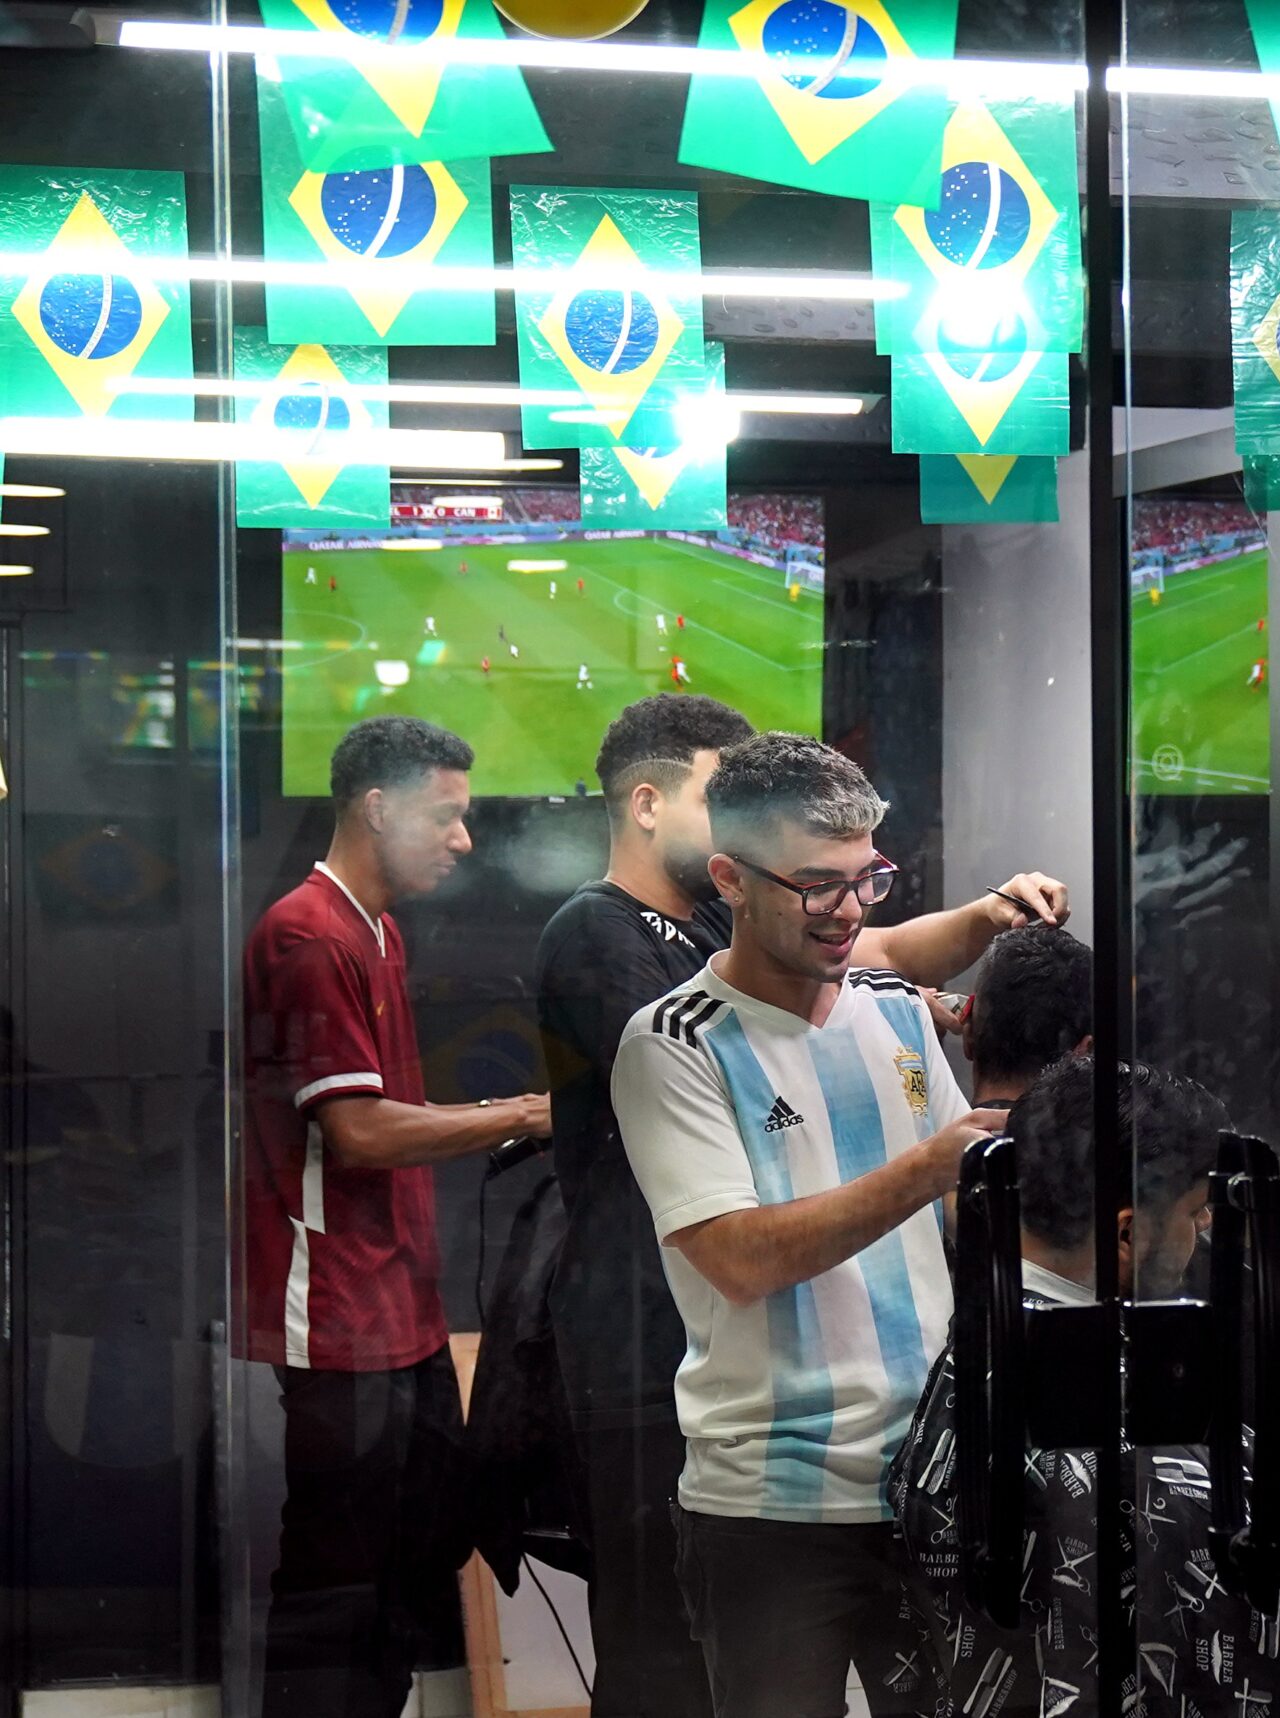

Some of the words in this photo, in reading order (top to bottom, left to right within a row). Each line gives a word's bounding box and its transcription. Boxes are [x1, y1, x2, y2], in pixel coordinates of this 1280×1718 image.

[454, 505, 478, 518] CAN
[308, 540, 345, 552] QATAR
[764, 1113, 805, 1134] adidas
[1081, 1450, 1099, 1480] HOP
[1060, 1458, 1086, 1500] BARBE
[919, 1552, 960, 1565] BARBE
[925, 1566, 959, 1578] SHOP
[961, 1625, 977, 1658] SHOP
[1195, 1637, 1210, 1672] SHOP
[1222, 1633, 1236, 1684] BARBER
